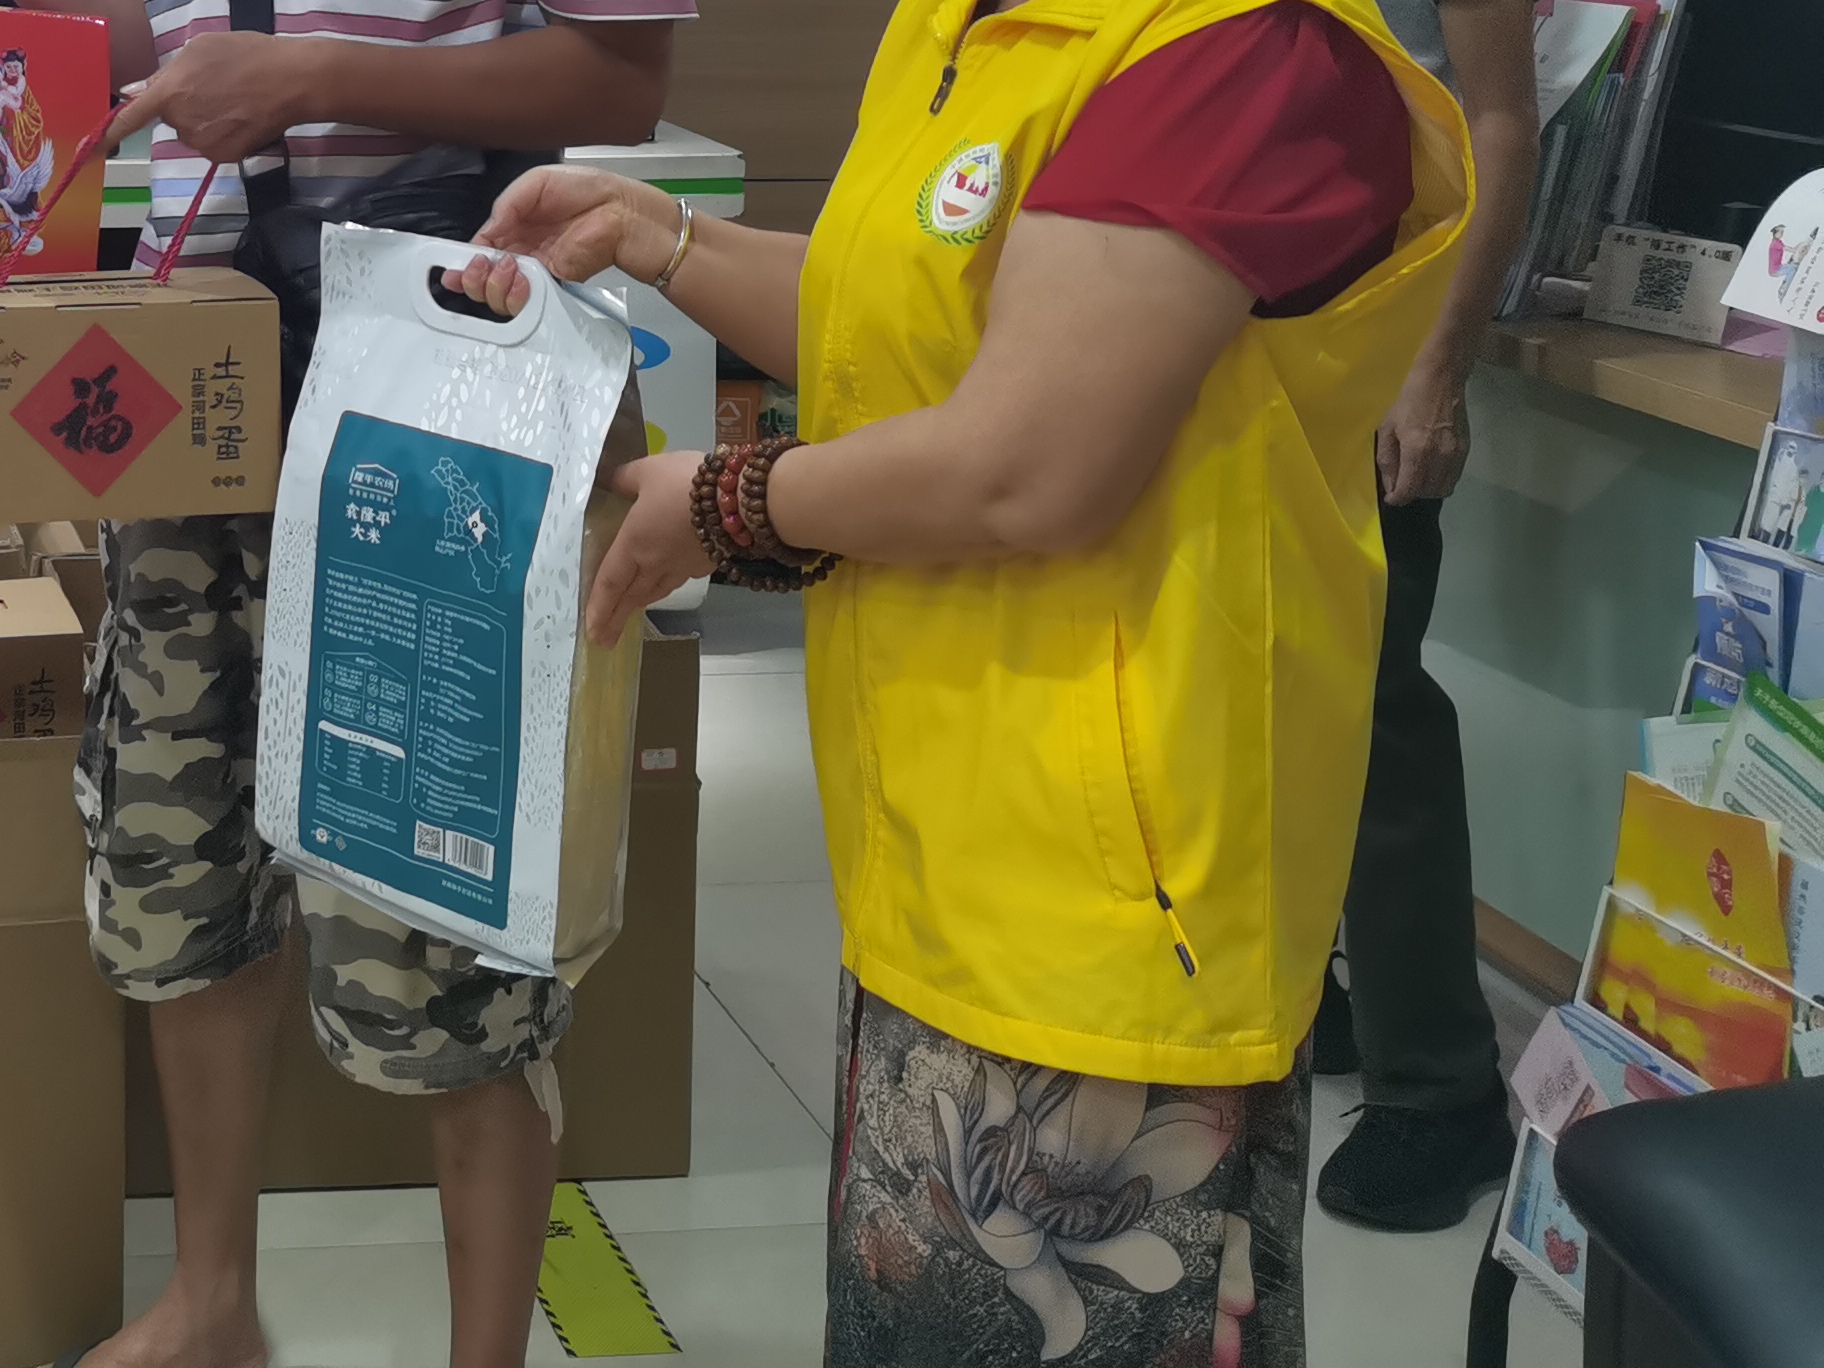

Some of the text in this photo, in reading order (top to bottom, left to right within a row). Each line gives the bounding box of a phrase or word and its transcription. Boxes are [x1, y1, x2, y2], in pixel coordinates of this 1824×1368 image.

[50, 364, 134, 455] 福
[209, 343, 249, 461] 土鸡蛋
[344, 501, 392, 528] 袁隆平
[350, 523, 382, 545] 大米
